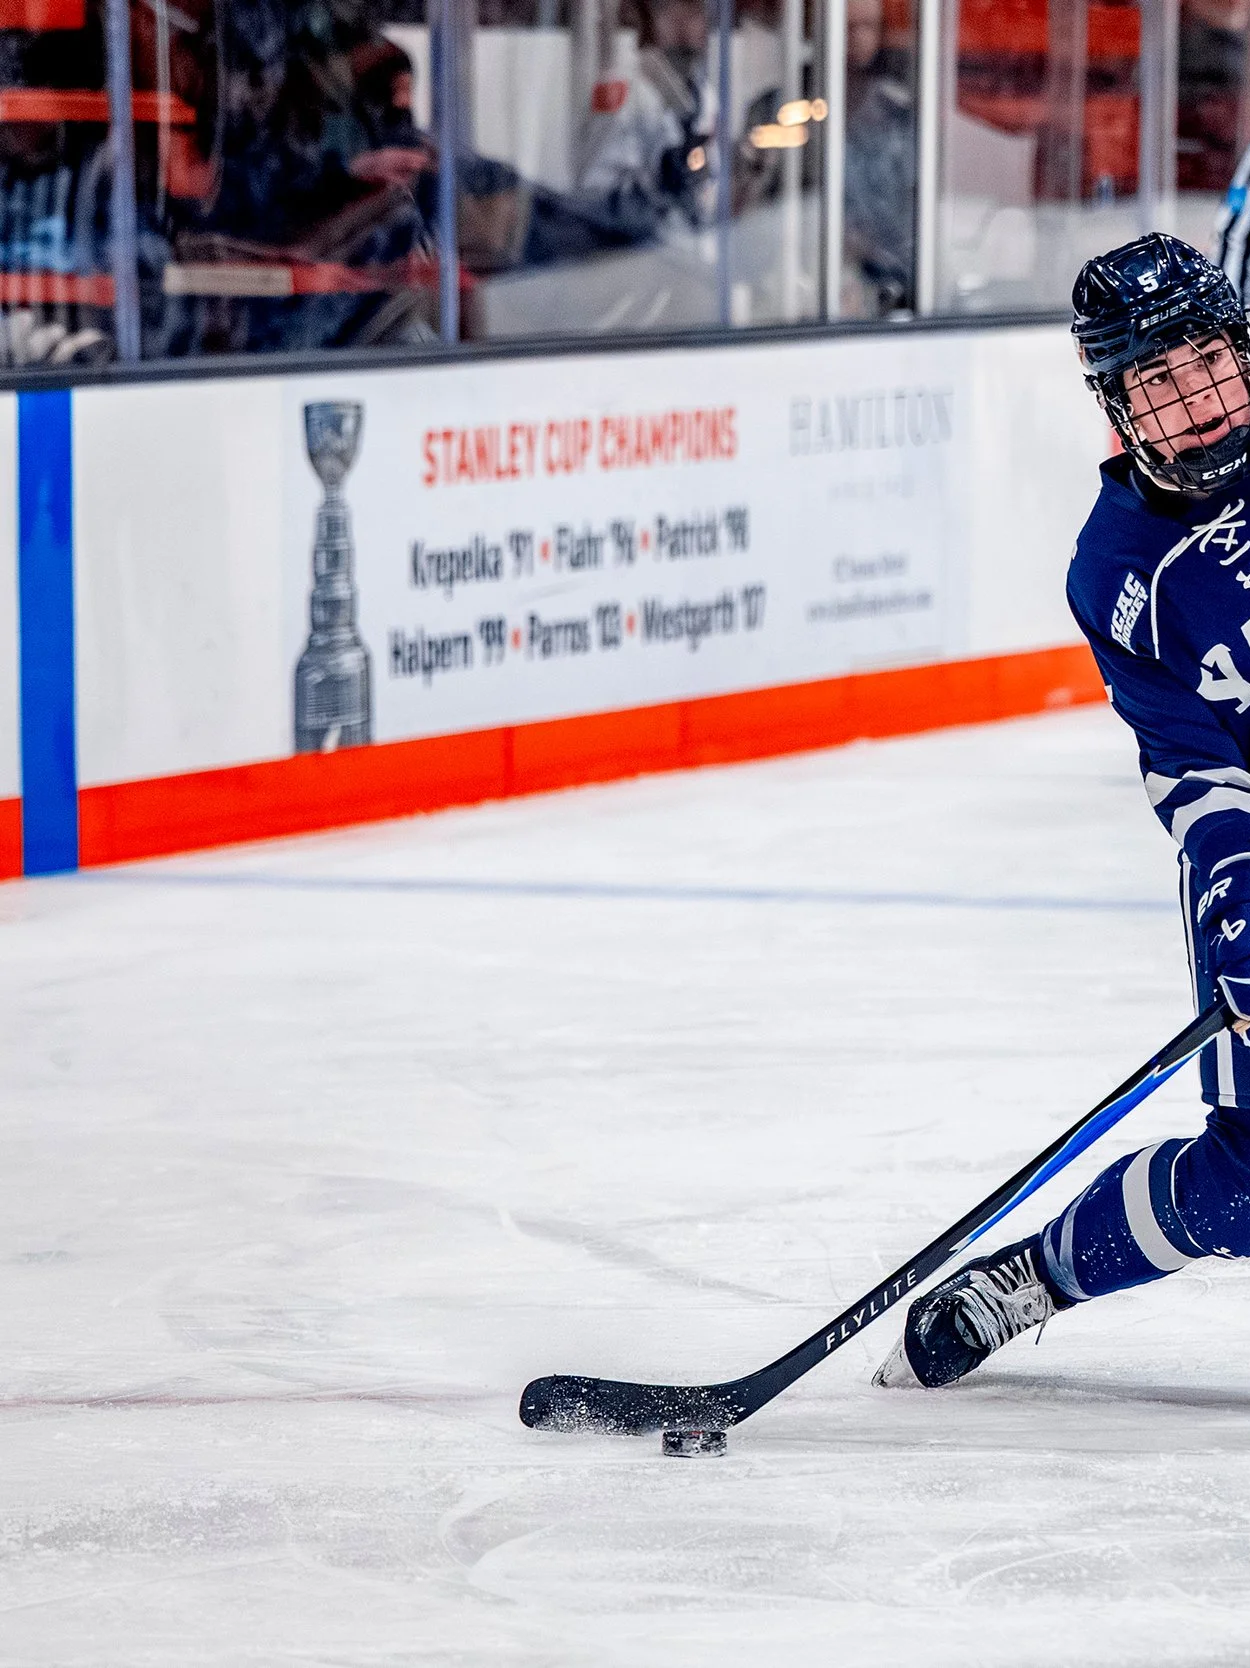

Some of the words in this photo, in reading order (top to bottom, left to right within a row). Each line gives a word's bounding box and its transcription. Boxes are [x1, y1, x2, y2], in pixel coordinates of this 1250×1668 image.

[1137, 271, 1159, 293] 5
[421, 422, 541, 488] STANLEY
[544, 415, 592, 478] CUP
[598, 404, 738, 473] CHAMPIONS
[1201, 452, 1247, 480] CCM
[408, 532, 503, 601] Krepelka
[654, 512, 719, 562] Patrick
[388, 624, 473, 689] Halpern
[526, 609, 592, 661] Parros
[639, 590, 736, 655] Westgarth
[825, 1268, 918, 1353] FLYLITE
